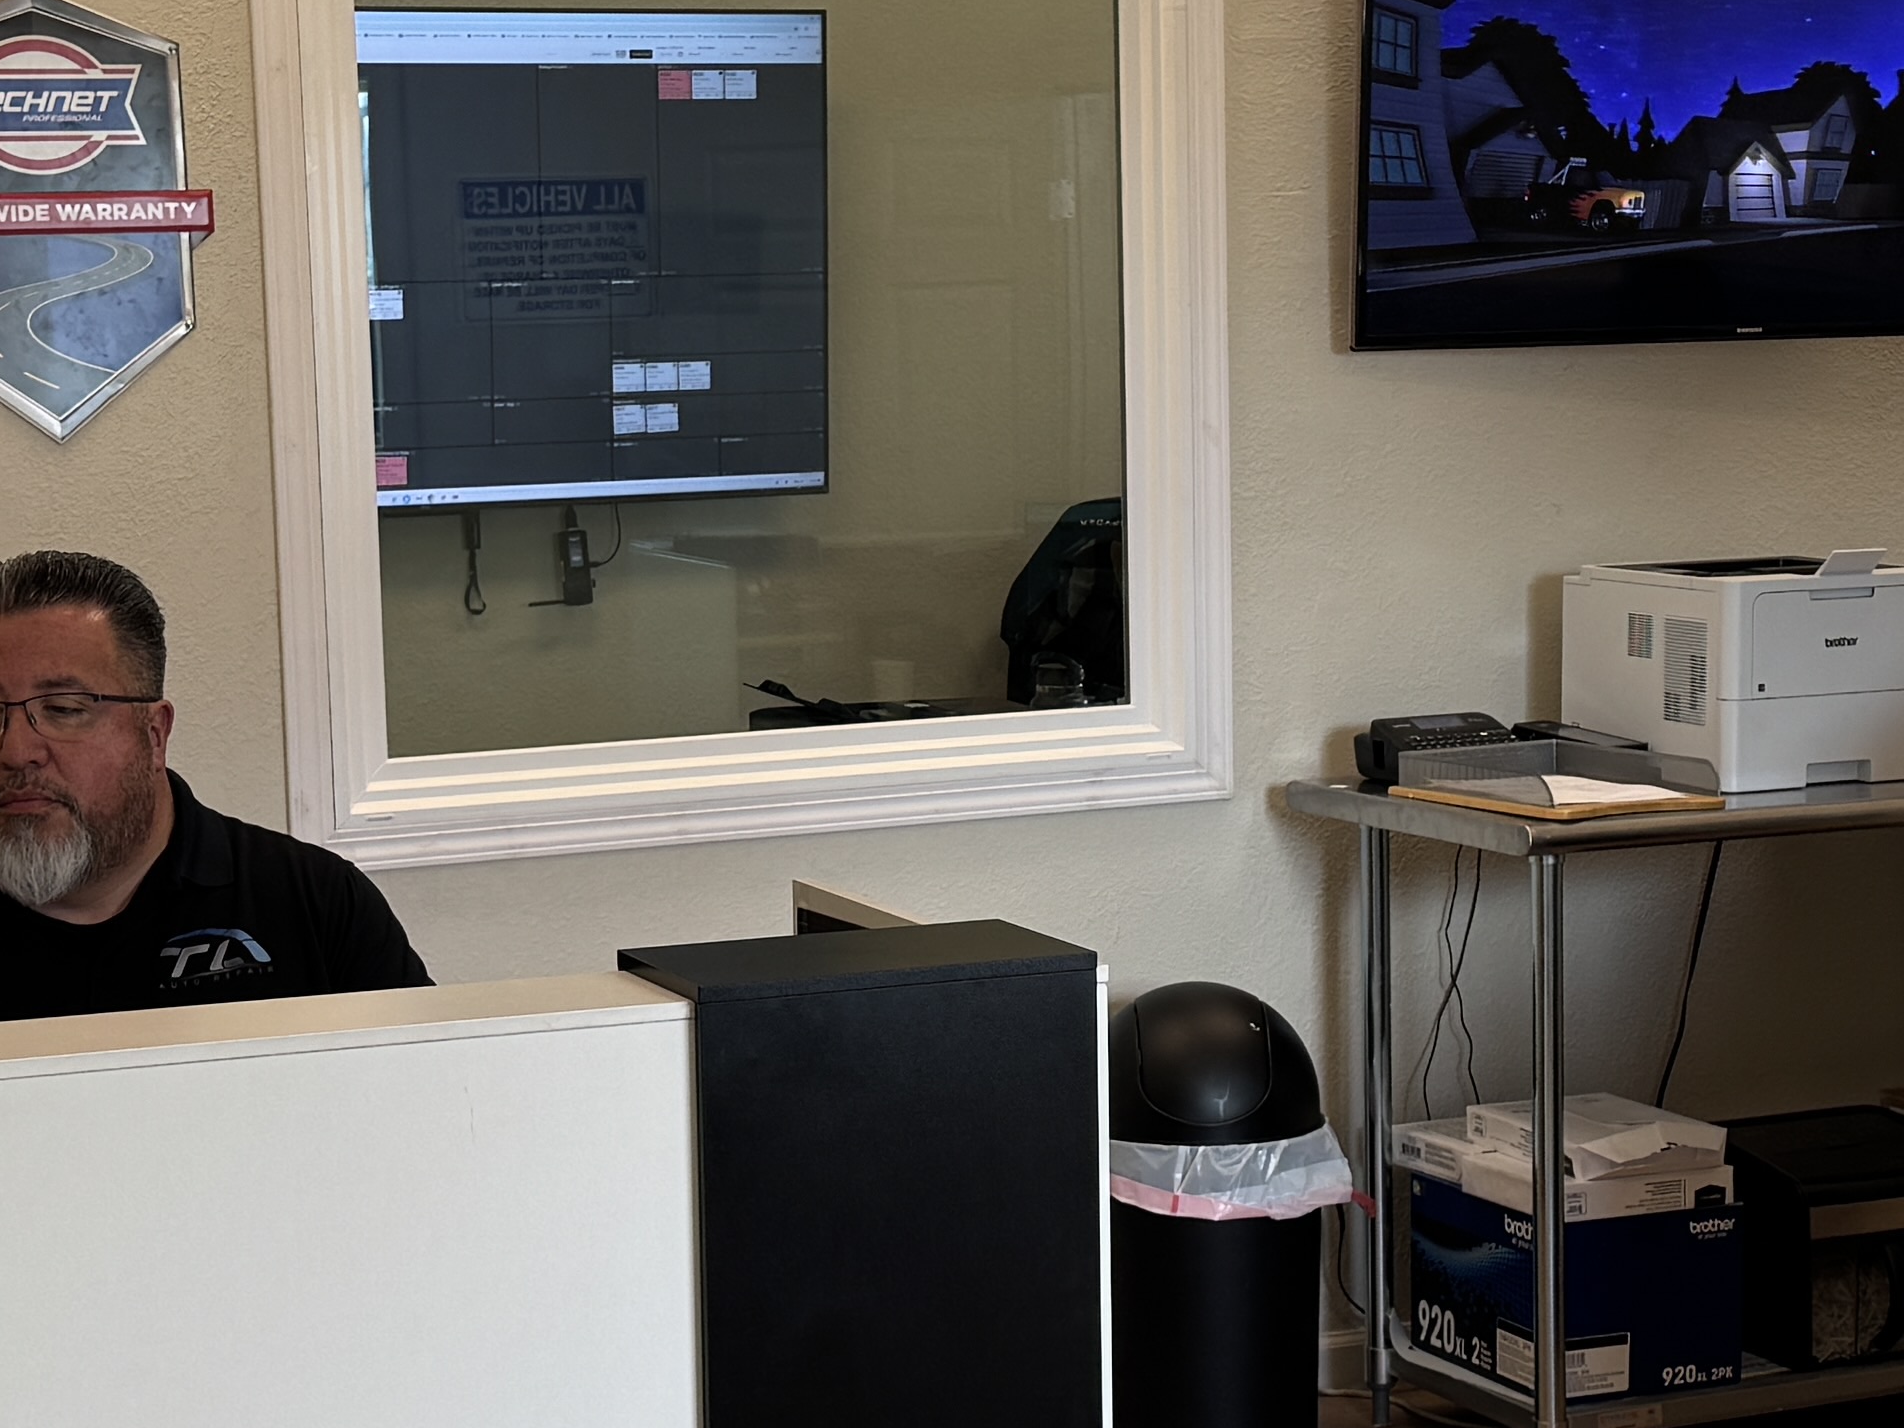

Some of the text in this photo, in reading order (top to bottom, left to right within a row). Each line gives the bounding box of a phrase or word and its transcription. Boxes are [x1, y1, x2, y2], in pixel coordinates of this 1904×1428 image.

[22, 113, 103, 122] PROFESSIONAL
[55, 201, 196, 222] WARRANTY
[1824, 636, 1859, 648] brother
[1689, 1218, 1736, 1234] brother
[1711, 1366, 1733, 1381] 2PK
